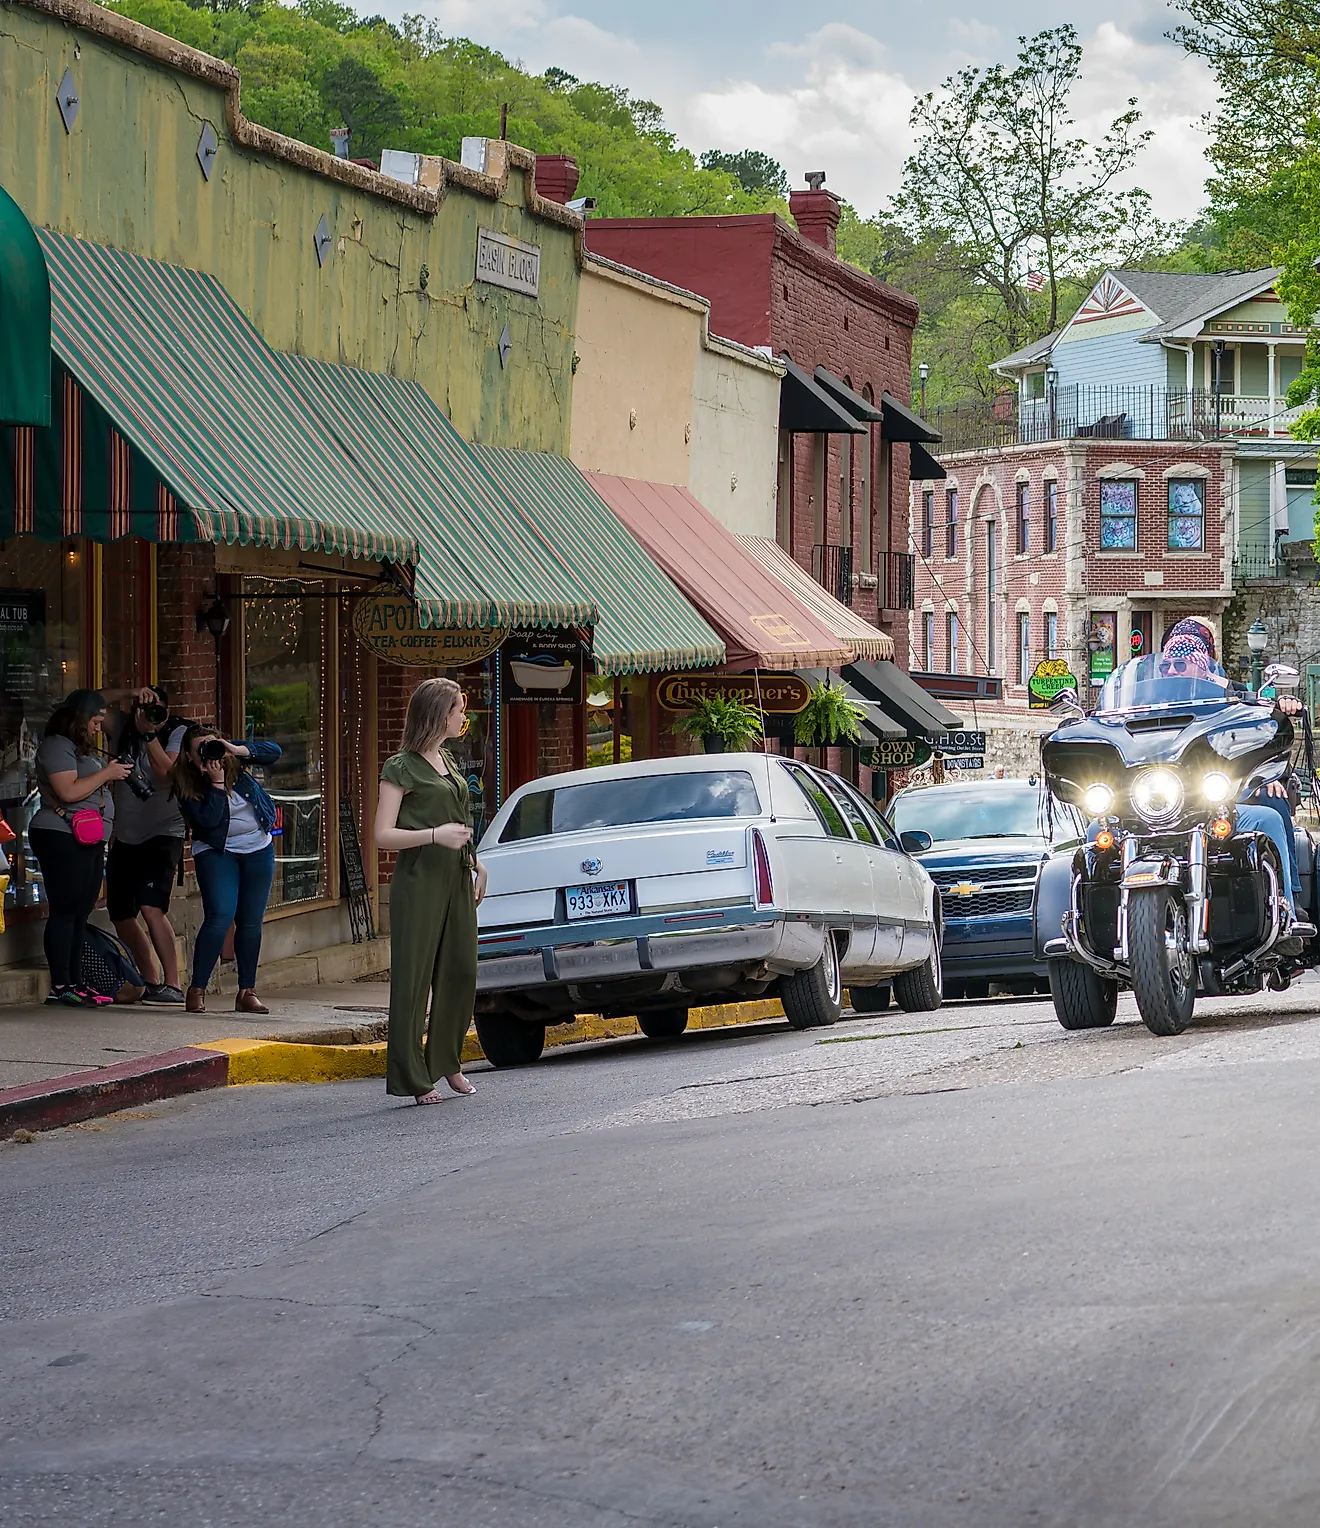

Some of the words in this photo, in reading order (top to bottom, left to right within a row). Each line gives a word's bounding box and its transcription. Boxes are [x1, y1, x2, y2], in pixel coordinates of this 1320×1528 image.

[479, 241, 505, 274] BASIN
[508, 251, 537, 288] BLOCK
[13, 607, 28, 620] TUB
[665, 680, 802, 706] Christopher's
[871, 752, 914, 765] SHOP
[946, 758, 982, 770] DOWNSTAIRS
[580, 884, 616, 895] Arkansas
[569, 894, 594, 911] 933
[602, 890, 627, 908] XKX
